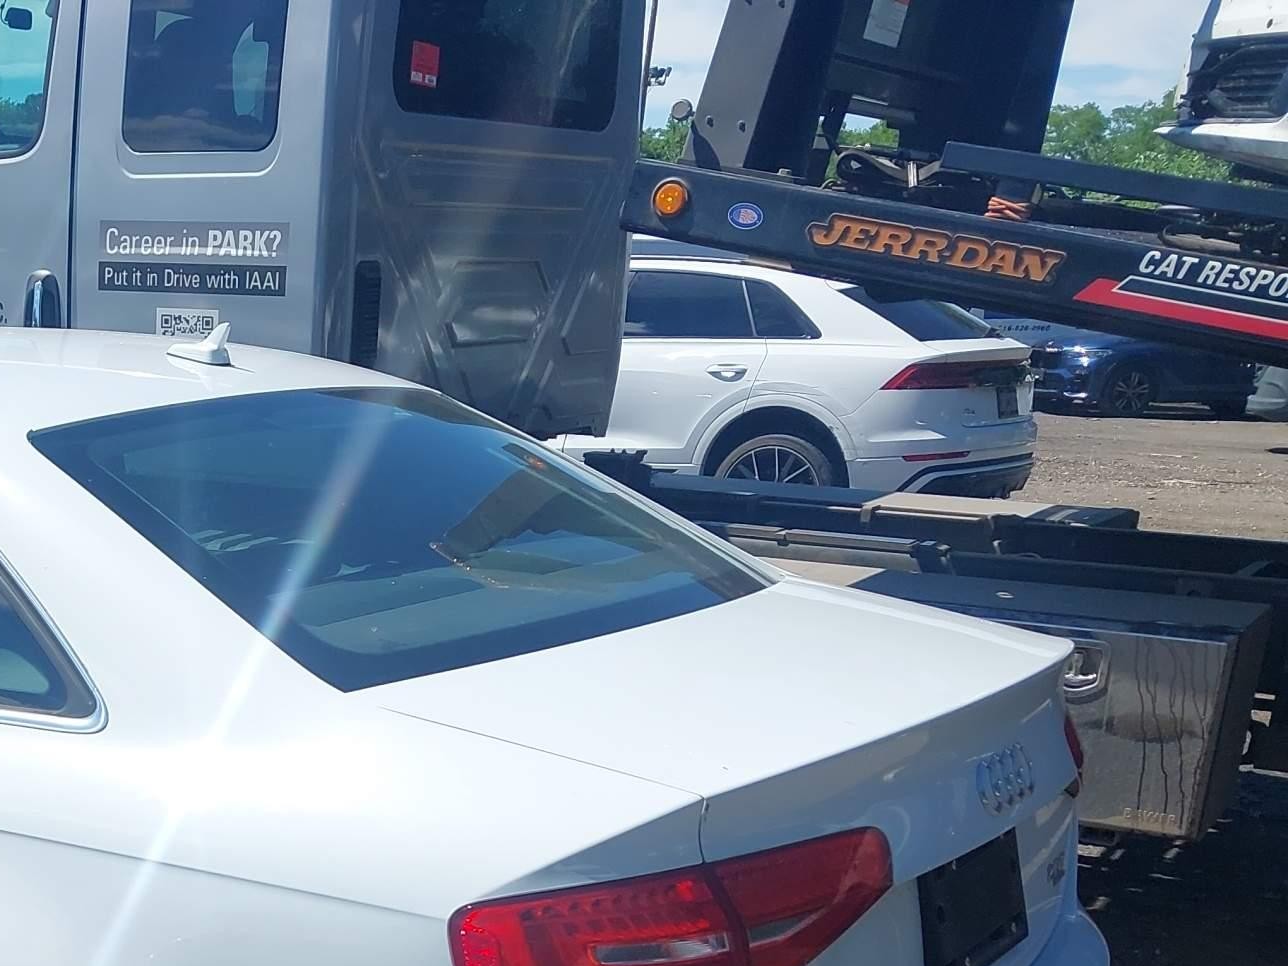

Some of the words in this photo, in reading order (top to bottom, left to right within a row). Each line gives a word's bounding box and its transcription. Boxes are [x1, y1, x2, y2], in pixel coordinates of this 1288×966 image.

[106, 227, 175, 255] Career
[181, 229, 199, 256] in
[206, 229, 282, 258] PARK?
[104, 267, 128, 287] Put
[132, 268, 142, 287] it
[146, 269, 158, 288] in
[164, 268, 200, 288] Drive
[206, 270, 239, 290] with
[245, 271, 280, 291] IAAI
[1138, 250, 1200, 280] CAT
[1197, 260, 1288, 298] RESPO
